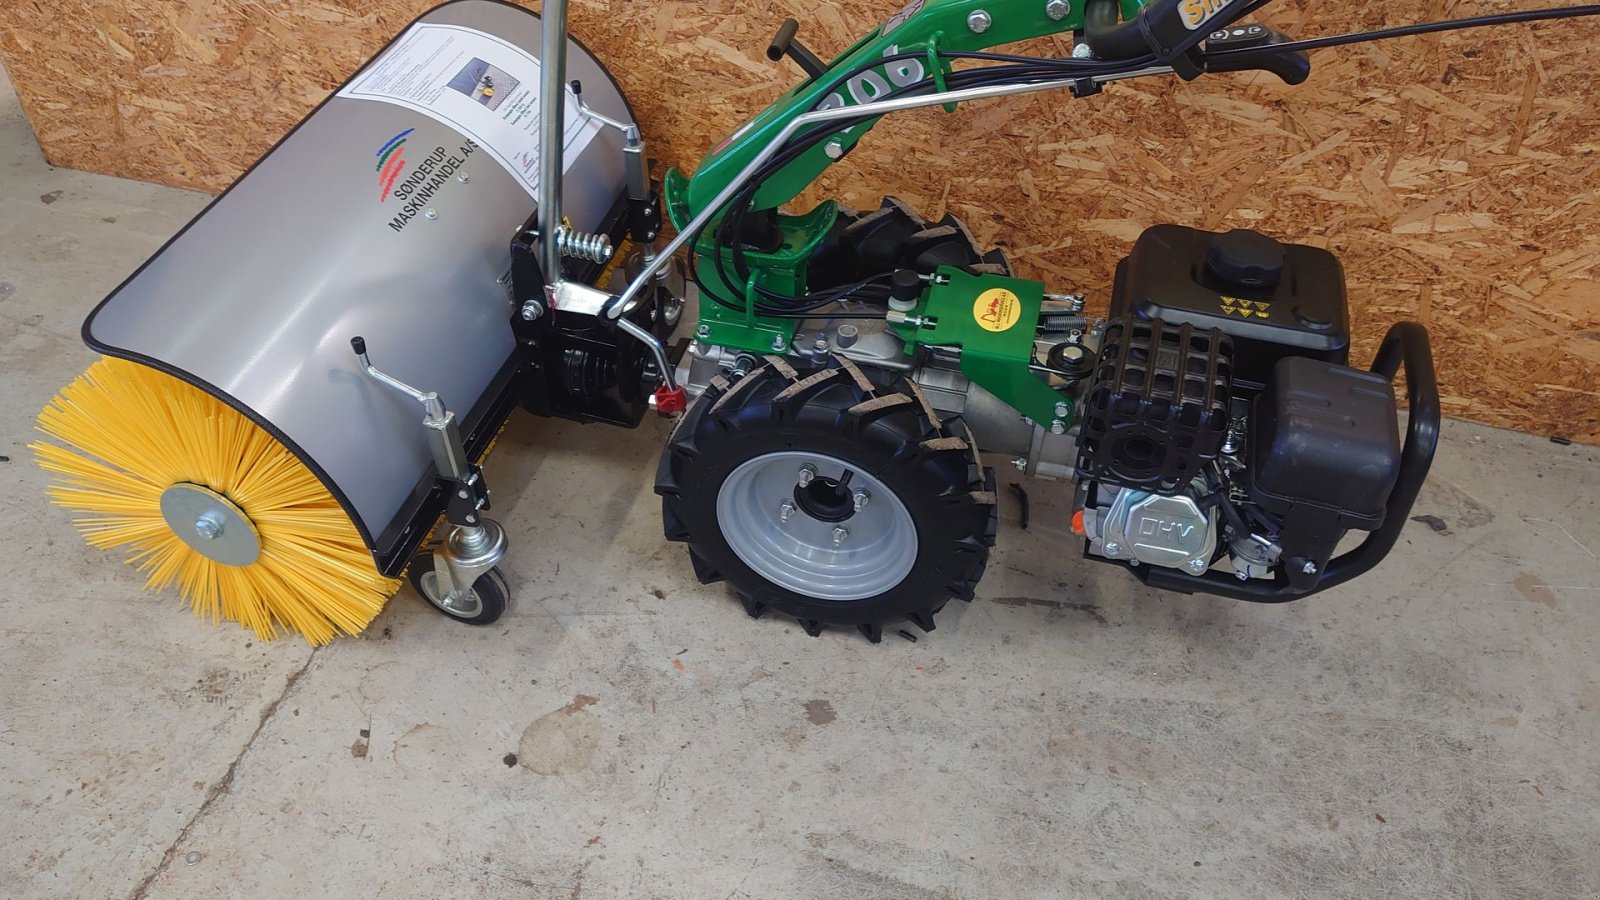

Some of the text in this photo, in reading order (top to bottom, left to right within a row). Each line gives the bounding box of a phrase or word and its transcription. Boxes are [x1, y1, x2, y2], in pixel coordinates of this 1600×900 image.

[388, 156, 465, 233] MASKINHANDEL
[459, 138, 479, 158] A/S
[393, 146, 447, 201] SØNDERUP
[1138, 517, 1194, 545] OHV
